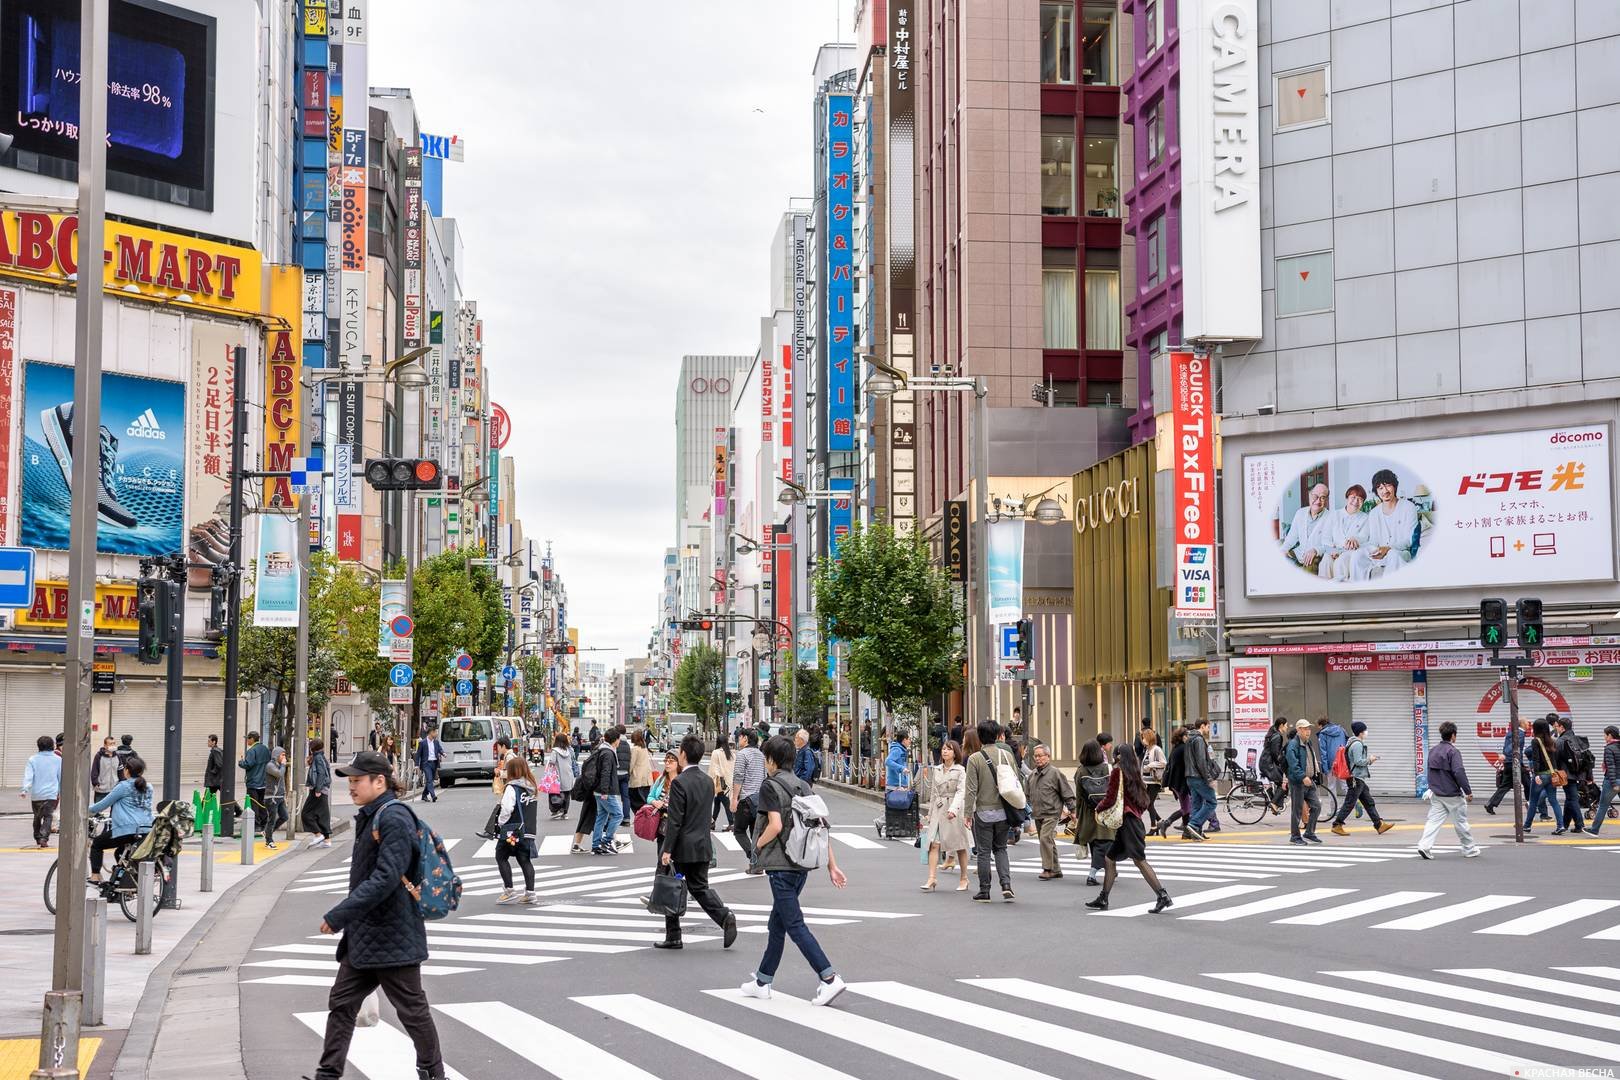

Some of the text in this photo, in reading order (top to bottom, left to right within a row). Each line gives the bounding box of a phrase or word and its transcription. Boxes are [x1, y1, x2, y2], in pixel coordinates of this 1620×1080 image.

[347, 26, 362, 37] 9F
[1213, 5, 1248, 214] CAMERA
[346, 131, 362, 143] 5F
[346, 153, 362, 165] 7F
[345, 169, 363, 183] 本
[306, 274, 321, 283] 5F
[328, 245, 339, 304] Euphoria
[796, 239, 805, 361] MEGANE TOP SHINJUKU
[346, 288, 358, 351] KEYUCA
[1189, 359, 1203, 417] QUICK
[346, 395, 355, 414] SUIT
[204, 366, 221, 477] 2足目半額
[126, 426, 166, 440] adidas
[1550, 431, 1603, 444] docomo
[1075, 477, 1141, 535] GUCCI
[950, 503, 961, 581] COACH
[1182, 569, 1211, 581] VISA
[1185, 588, 1206, 600] JCB
[395, 669, 404, 683] P
[1237, 671, 1264, 700] 薬
[1415, 708, 1424, 774] BIC CAMERA
